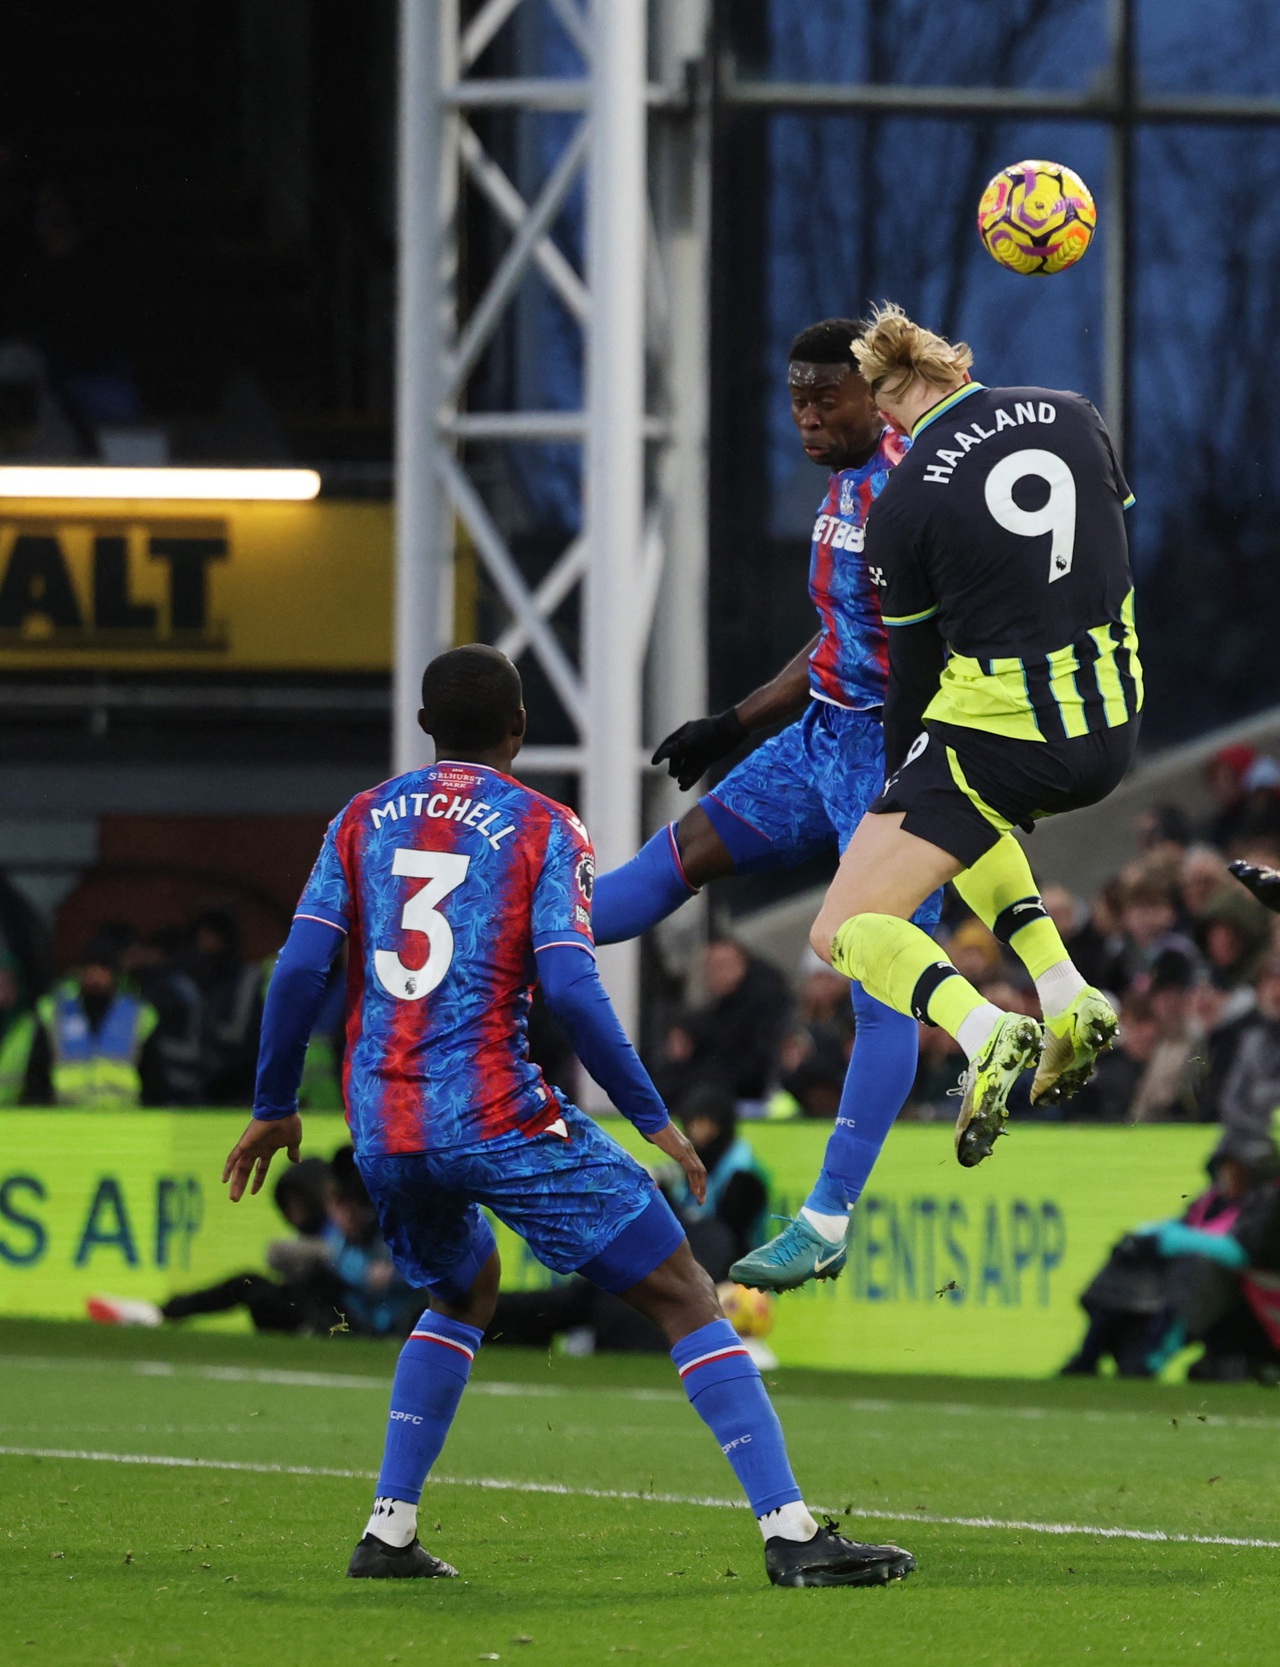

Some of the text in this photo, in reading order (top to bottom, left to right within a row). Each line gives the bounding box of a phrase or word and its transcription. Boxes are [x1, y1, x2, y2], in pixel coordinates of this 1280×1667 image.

[923, 401, 1057, 484] HAALAND
[812, 514, 865, 552] ET88
[984, 448, 1077, 584] 9
[370, 793, 516, 851] MITCHELL
[374, 848, 471, 1001] 3
[976, 1198, 1067, 1307] APP
[390, 1410, 424, 1425] CPFC
